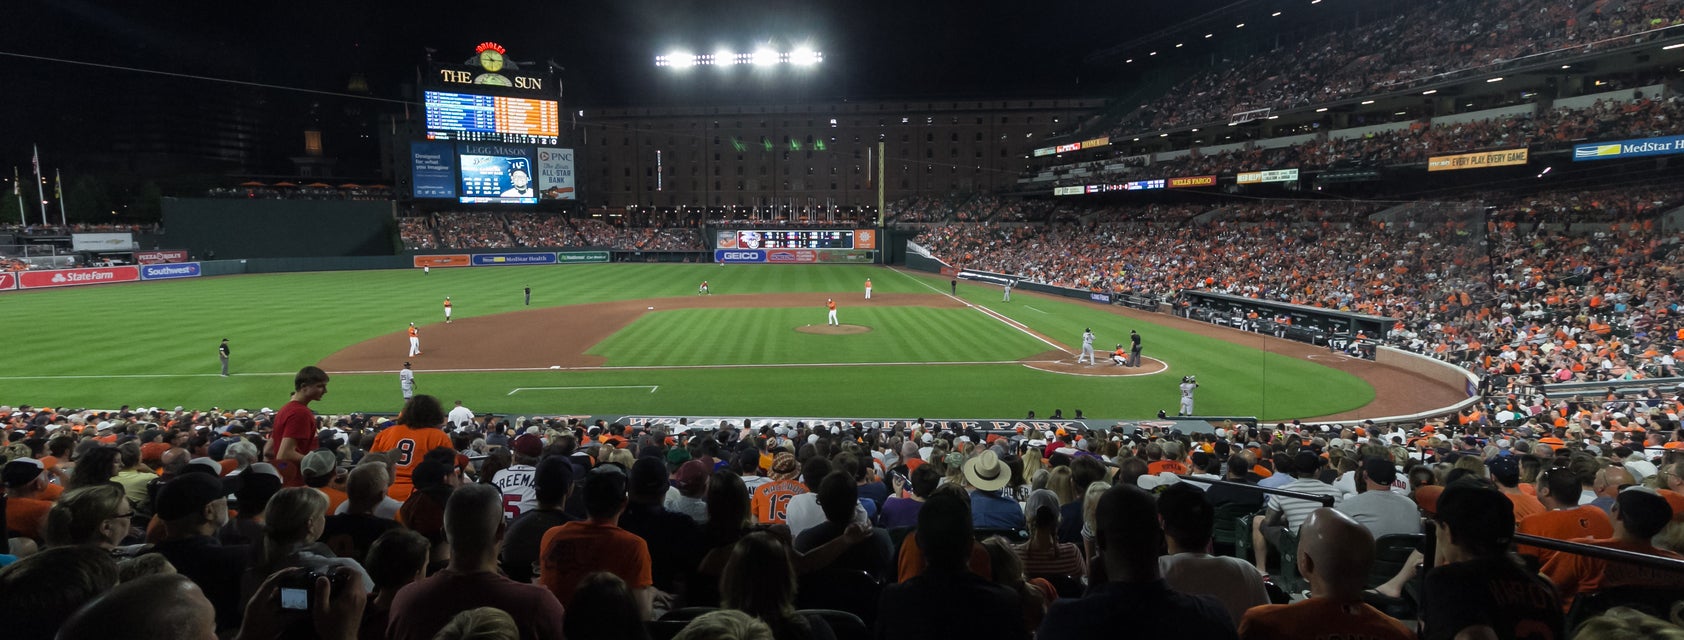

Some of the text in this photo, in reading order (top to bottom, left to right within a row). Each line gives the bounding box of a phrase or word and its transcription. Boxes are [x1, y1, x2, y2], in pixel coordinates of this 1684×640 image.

[476, 42, 506, 55] ORIOLES
[441, 69, 542, 90] THE SUN
[466, 144, 526, 156] LEGG MASON
[1623, 142, 1672, 154] MedStar
[551, 153, 572, 161] PNC
[1452, 157, 1470, 166] EVERY
[1486, 154, 1506, 164] EVERY
[1172, 177, 1212, 187] WELLS FARGO
[724, 252, 759, 260] GEICO
[148, 266, 189, 276] Southwest
[991, 420, 1080, 431] PARK
[396, 438, 415, 466] 8
[496, 473, 537, 489] REEMA
[503, 493, 523, 518] 5
[769, 493, 793, 521] 13
